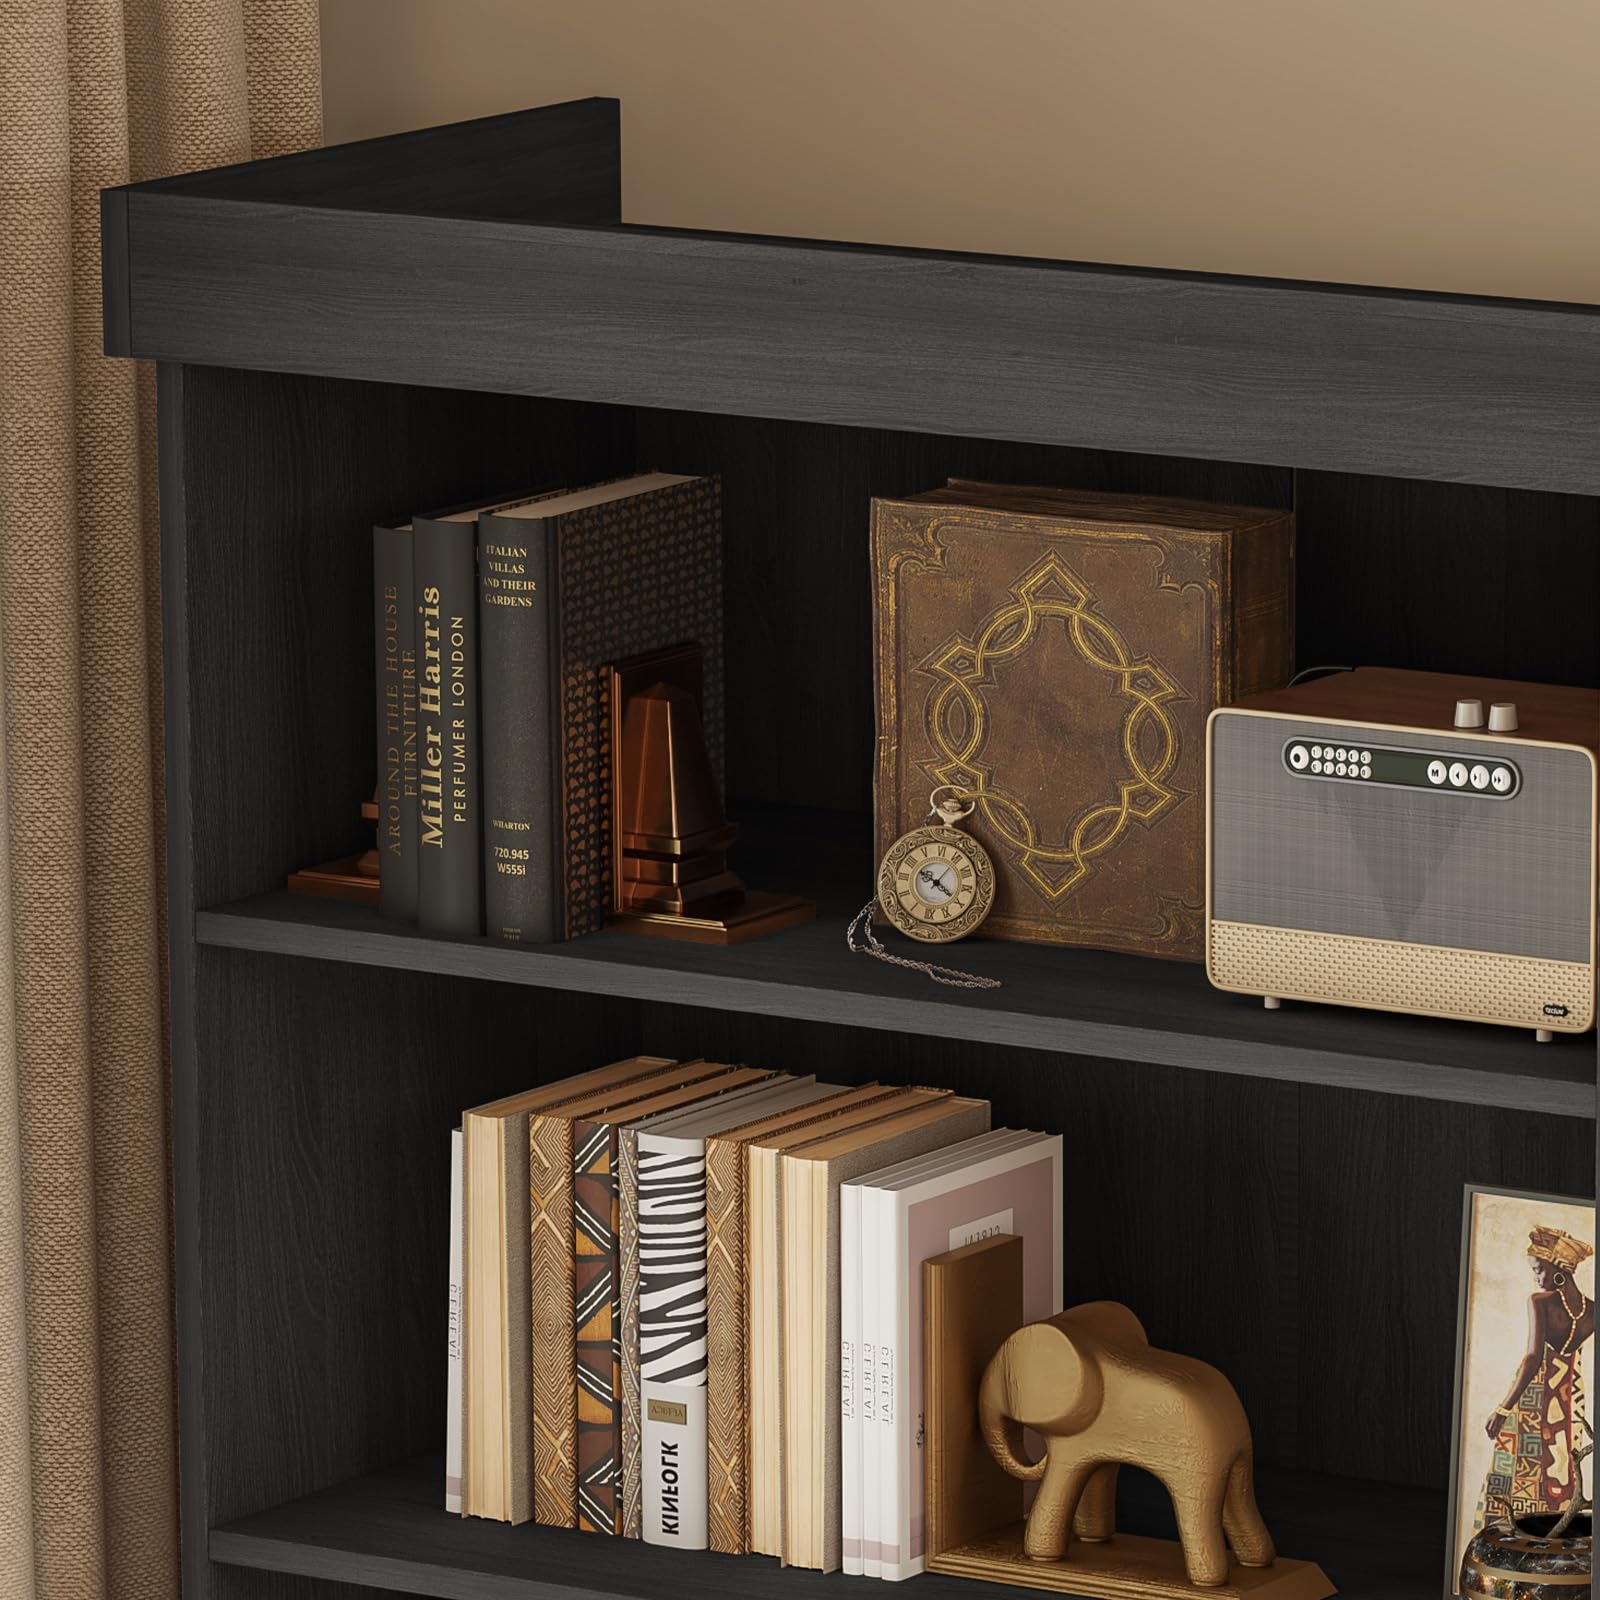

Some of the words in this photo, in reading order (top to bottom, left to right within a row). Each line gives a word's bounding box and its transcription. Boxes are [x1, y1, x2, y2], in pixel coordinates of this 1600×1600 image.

[486, 544, 527, 557] ITALIAN
[488, 561, 525, 574] VILLAS
[485, 593, 533, 607] GARDENS
[502, 579, 536, 591] THEIR
[385, 586, 398, 672] HOUSE
[419, 586, 441, 716] Harris
[451, 616, 465, 707] LONDON
[386, 685, 399, 735] THE
[403, 650, 417, 796] FURNITURE
[452, 719, 466, 822] PERFUMER
[1432, 769, 1440, 777] M
[387, 747, 401, 856] AROUND
[421, 725, 443, 849] Miller
[492, 819, 530, 831] WHARTON
[494, 846, 529, 860] 720.945
[497, 862, 526, 876] W555i
